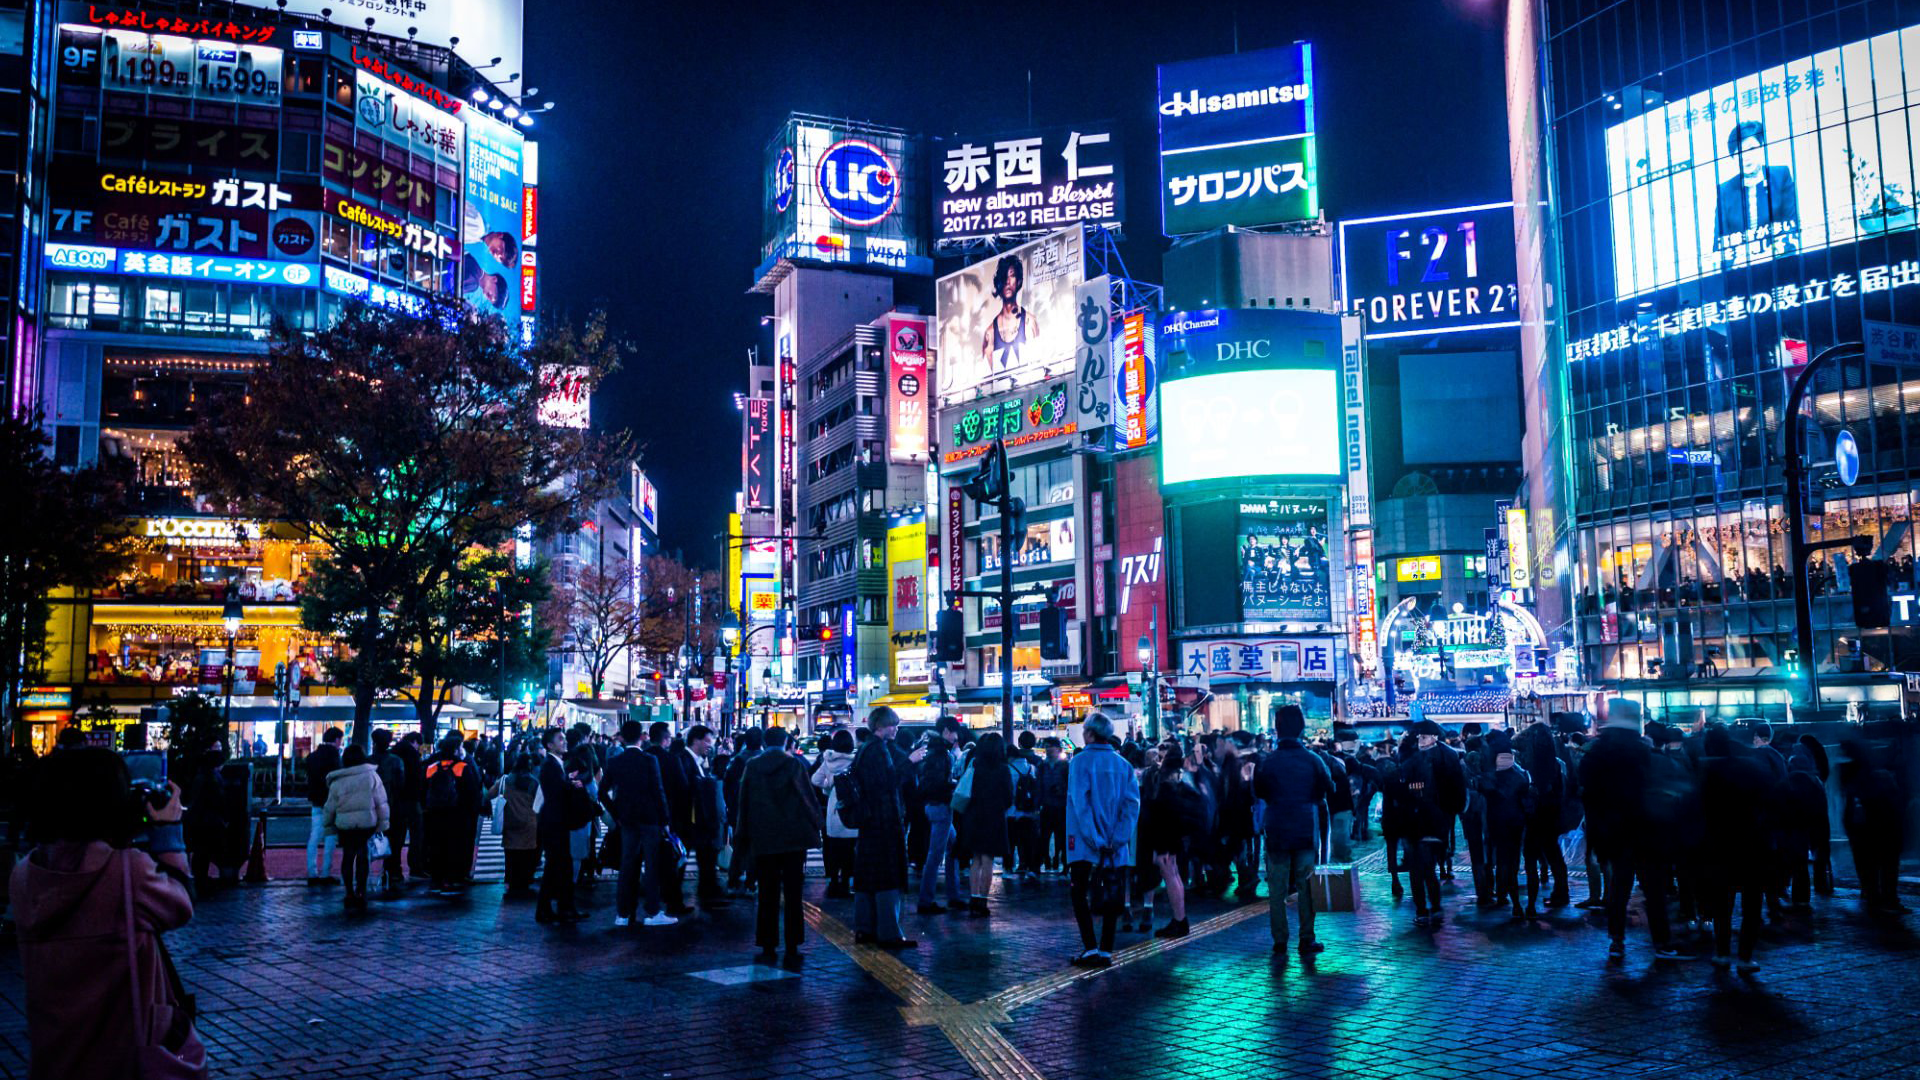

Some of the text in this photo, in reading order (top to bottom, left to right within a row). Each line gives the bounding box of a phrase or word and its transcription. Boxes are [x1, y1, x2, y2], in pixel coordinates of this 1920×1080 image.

[89, 5, 276, 43] しゃぶしゃぶバイキング
[63, 46, 98, 68] 9F
[351, 45, 462, 115] しゃぶしゃぶバイキング
[1159, 83, 1310, 118] Hisamitsu
[104, 119, 271, 160] プライス
[391, 102, 457, 155] しゃぶ葉
[323, 143, 431, 208] コンタクト
[1168, 162, 1309, 206] サロンパス
[211, 178, 292, 211] ガスト
[500, 196, 518, 213] SALE
[943, 197, 982, 215] new
[986, 191, 1044, 210] album
[52, 208, 94, 233] 7F
[103, 212, 150, 231] Café
[155, 213, 259, 253] ガスト
[943, 201, 1115, 233] 2017.12.12 RELEASE
[104, 230, 149, 243] レストラン
[277, 233, 311, 246] ガスト
[404, 222, 453, 260] ガスト
[869, 245, 905, 260] VISA
[54, 250, 107, 268] AEON
[123, 251, 276, 281] 英会話イーオン
[286, 266, 306, 280] 6F
[1353, 286, 1482, 324] FOREVER
[1163, 316, 1219, 335] DHC Channel
[1077, 295, 1110, 422] もんじゃ
[1215, 339, 1271, 362] DHC
[1124, 318, 1142, 441] 三千里薬品
[1347, 414, 1361, 472] neon
[1240, 504, 1324, 514] DMM バヌーシー
[1121, 536, 1162, 615] クスリ
[1057, 582, 1075, 603] JTB
